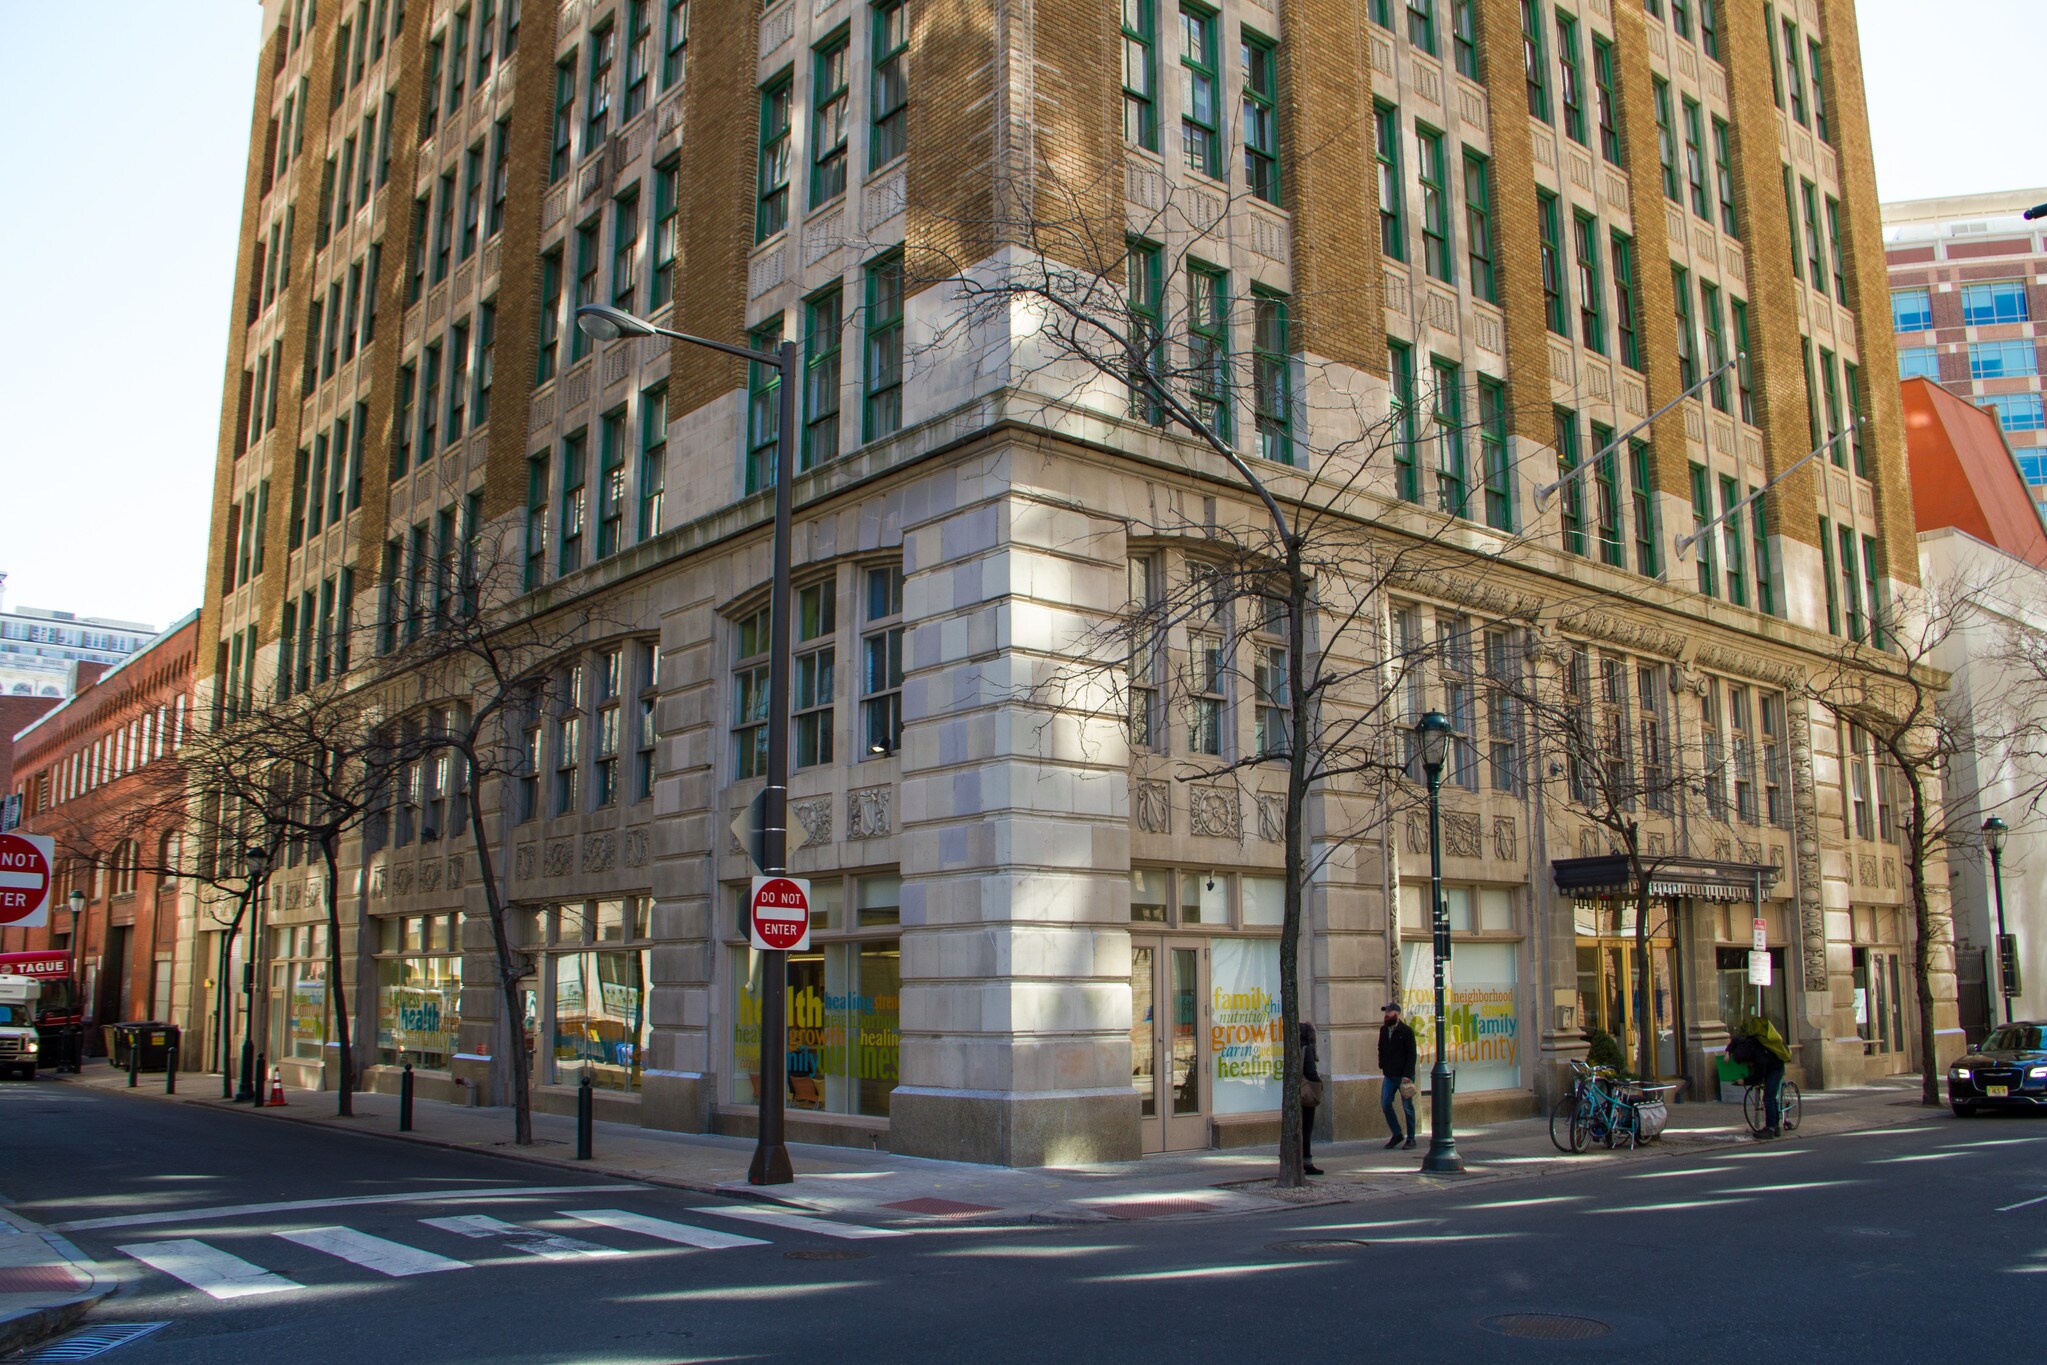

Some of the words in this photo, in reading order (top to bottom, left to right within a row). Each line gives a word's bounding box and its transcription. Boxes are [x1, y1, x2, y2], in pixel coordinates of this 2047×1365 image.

[1, 852, 38, 868] NOT
[761, 891, 775, 903] DO
[781, 893, 801, 905] NOT
[765, 923, 797, 935] ENTER
[17, 962, 64, 974] TAGUE
[825, 991, 874, 1015] healing
[1213, 987, 1273, 1016] family
[1453, 988, 1513, 1006] neighborhood
[401, 1001, 439, 1031] health
[1220, 1008, 1270, 1025] nutrition
[1471, 1013, 1517, 1037] family
[789, 1024, 845, 1053] growth
[1217, 1056, 1284, 1081] healing
